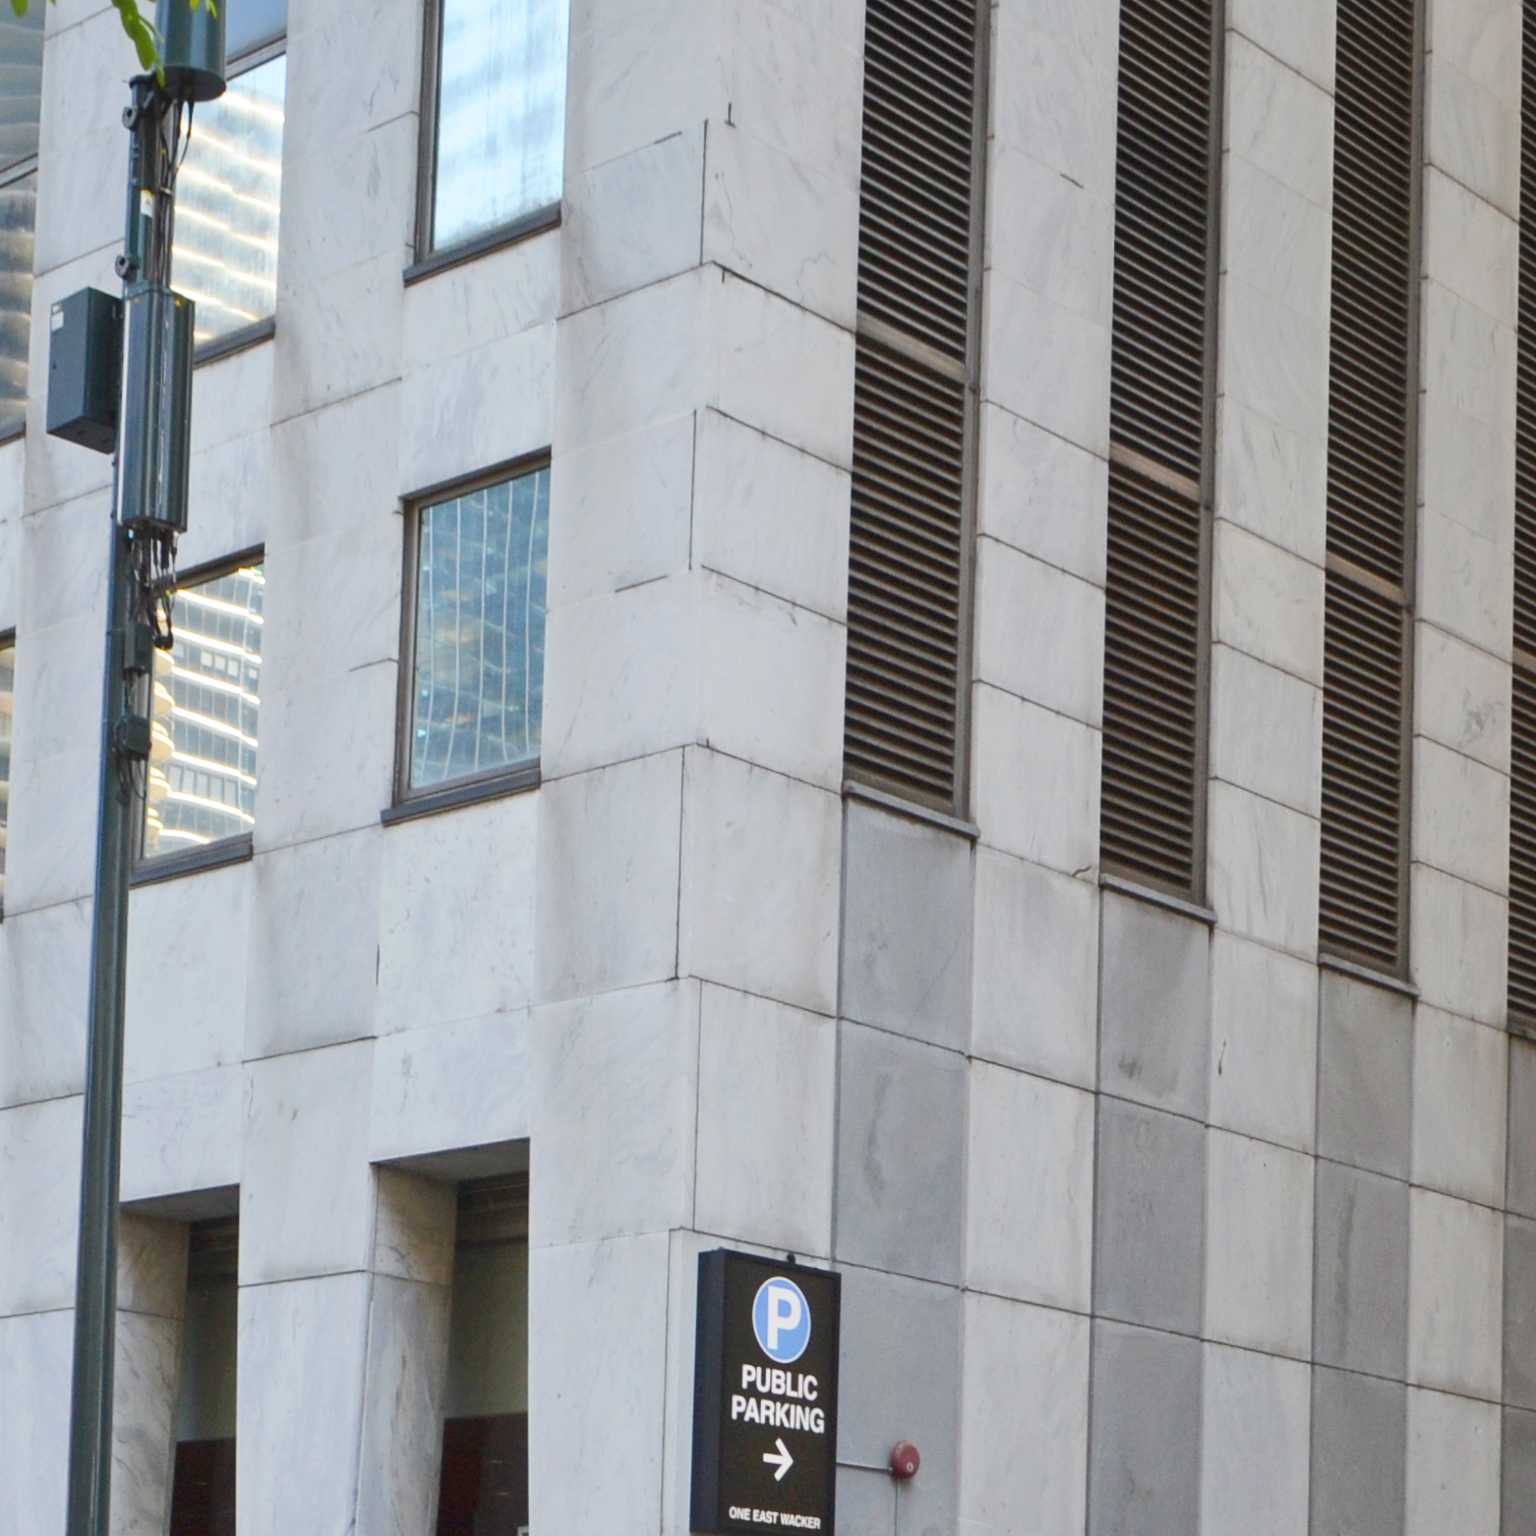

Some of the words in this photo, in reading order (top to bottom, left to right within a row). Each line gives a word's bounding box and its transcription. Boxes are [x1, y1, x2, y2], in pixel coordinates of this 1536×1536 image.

[767, 1285, 801, 1350] P
[741, 1363, 818, 1401] PUBLIC
[730, 1394, 825, 1434] PARKING
[728, 1505, 751, 1521] ONE
[751, 1508, 779, 1525] EAST
[780, 1512, 822, 1531] WACKER
